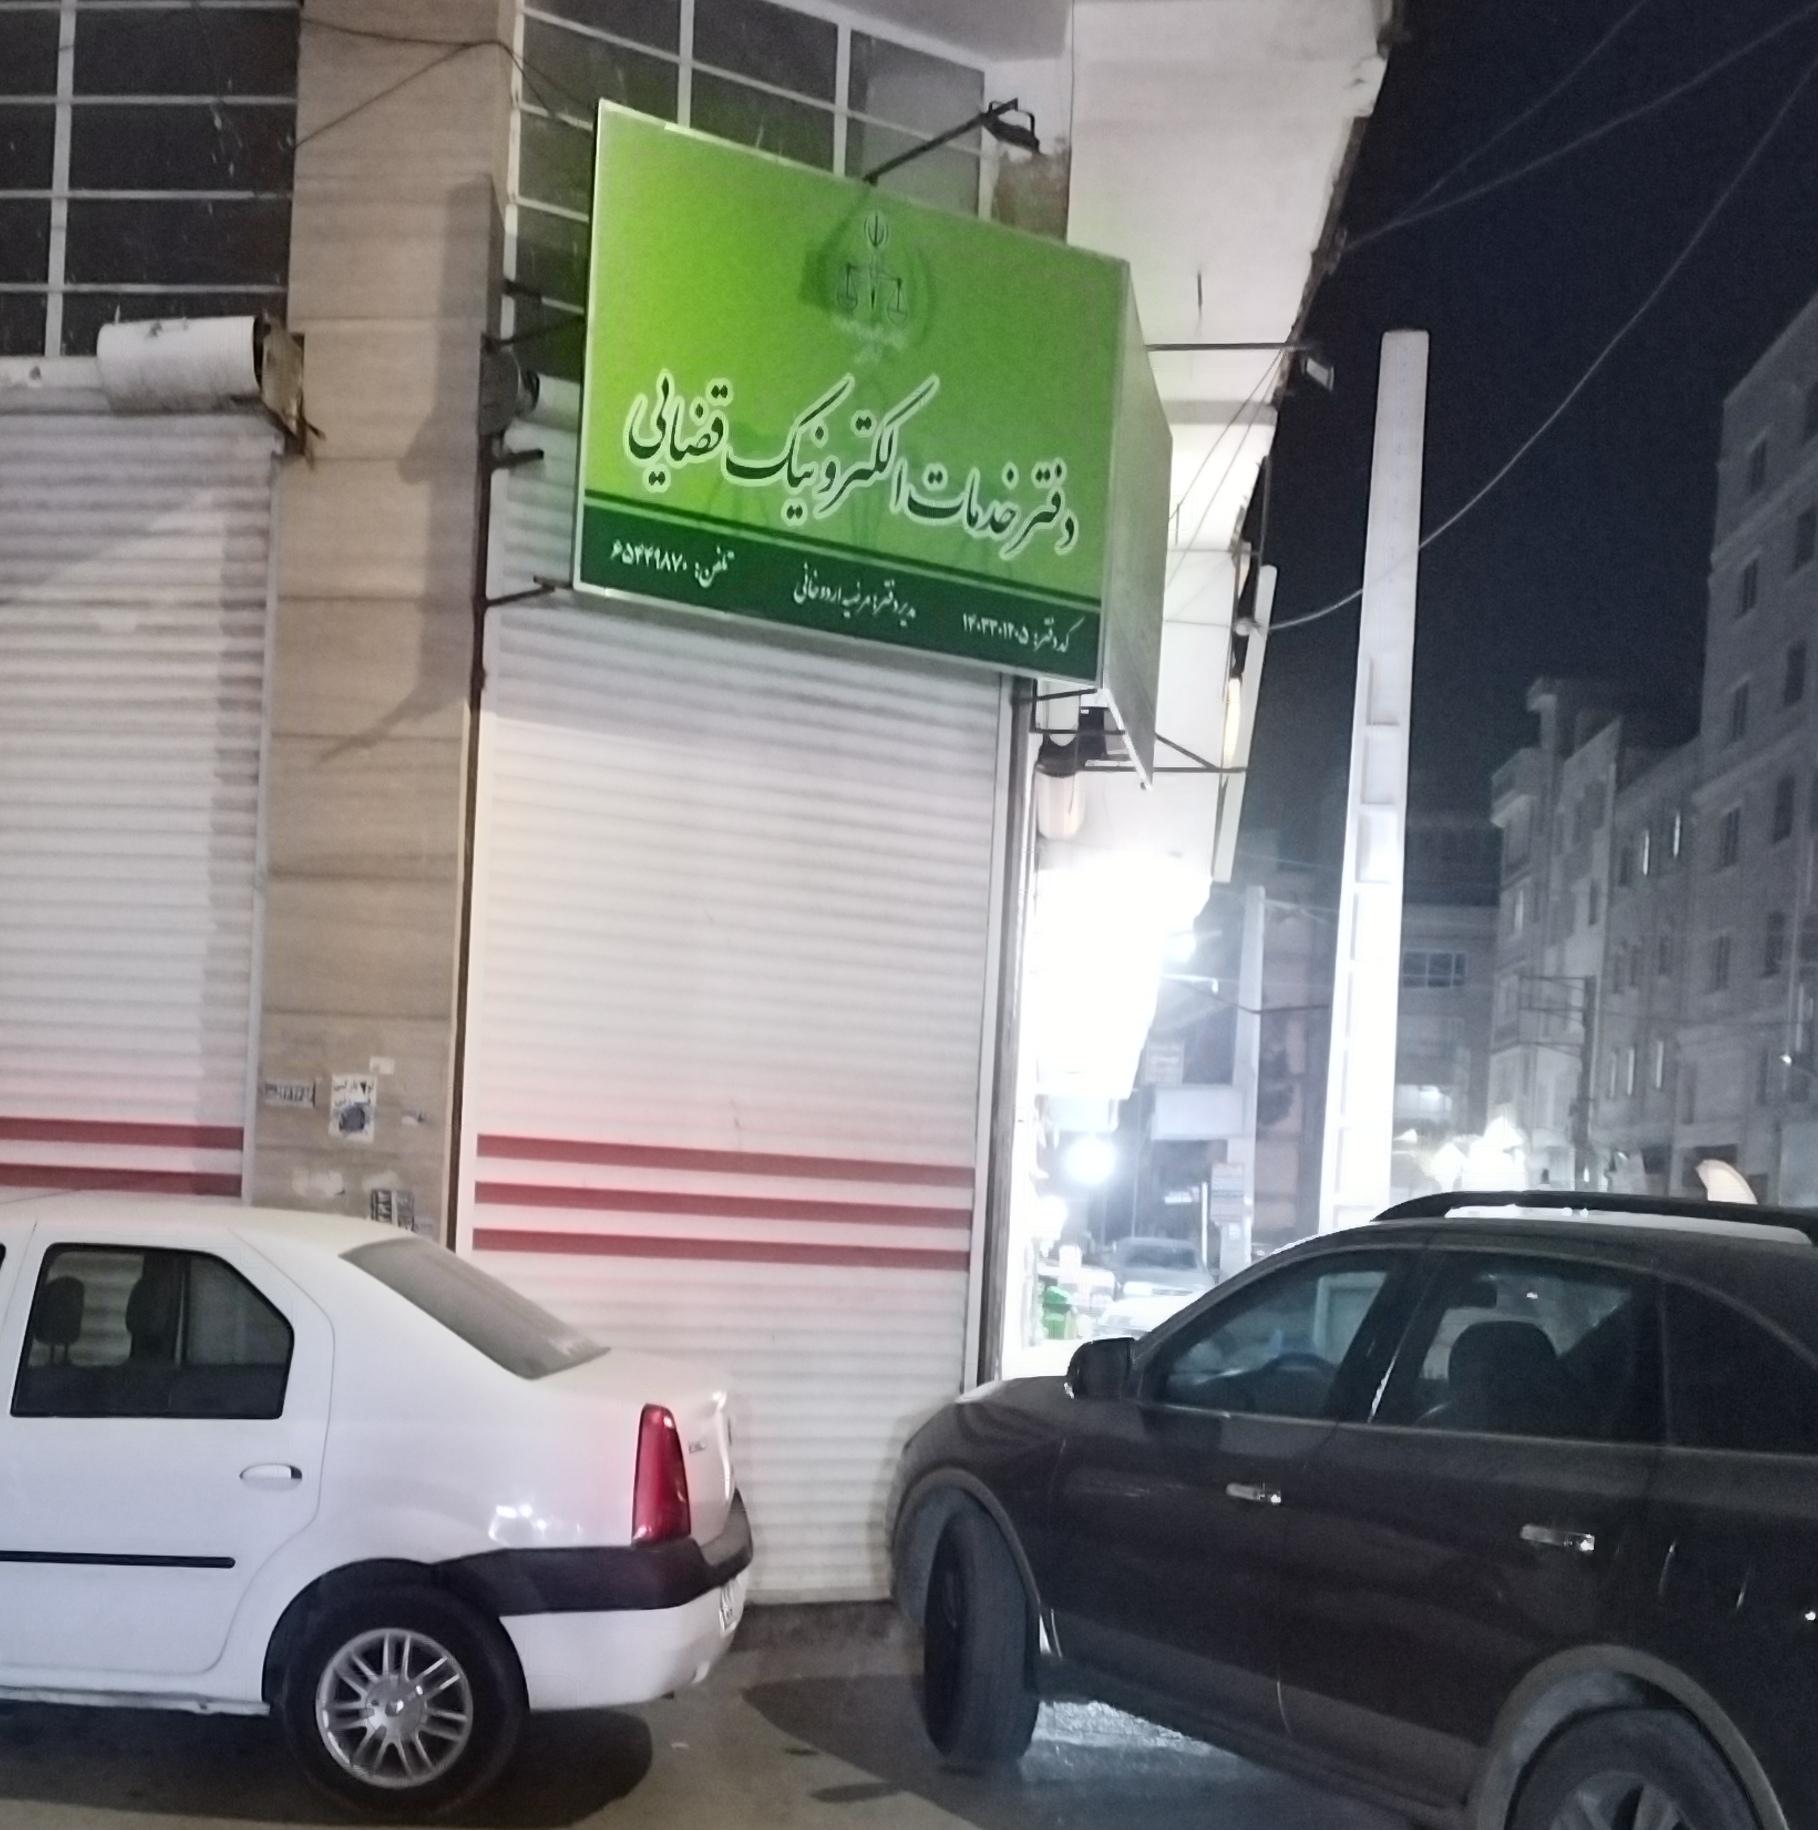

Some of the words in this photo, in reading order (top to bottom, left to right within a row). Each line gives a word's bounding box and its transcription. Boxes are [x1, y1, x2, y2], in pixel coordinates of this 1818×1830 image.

[721, 373, 940, 525] الکترونیک
[905, 463, 1021, 535] خدمات
[999, 457, 1080, 560] دفتر
